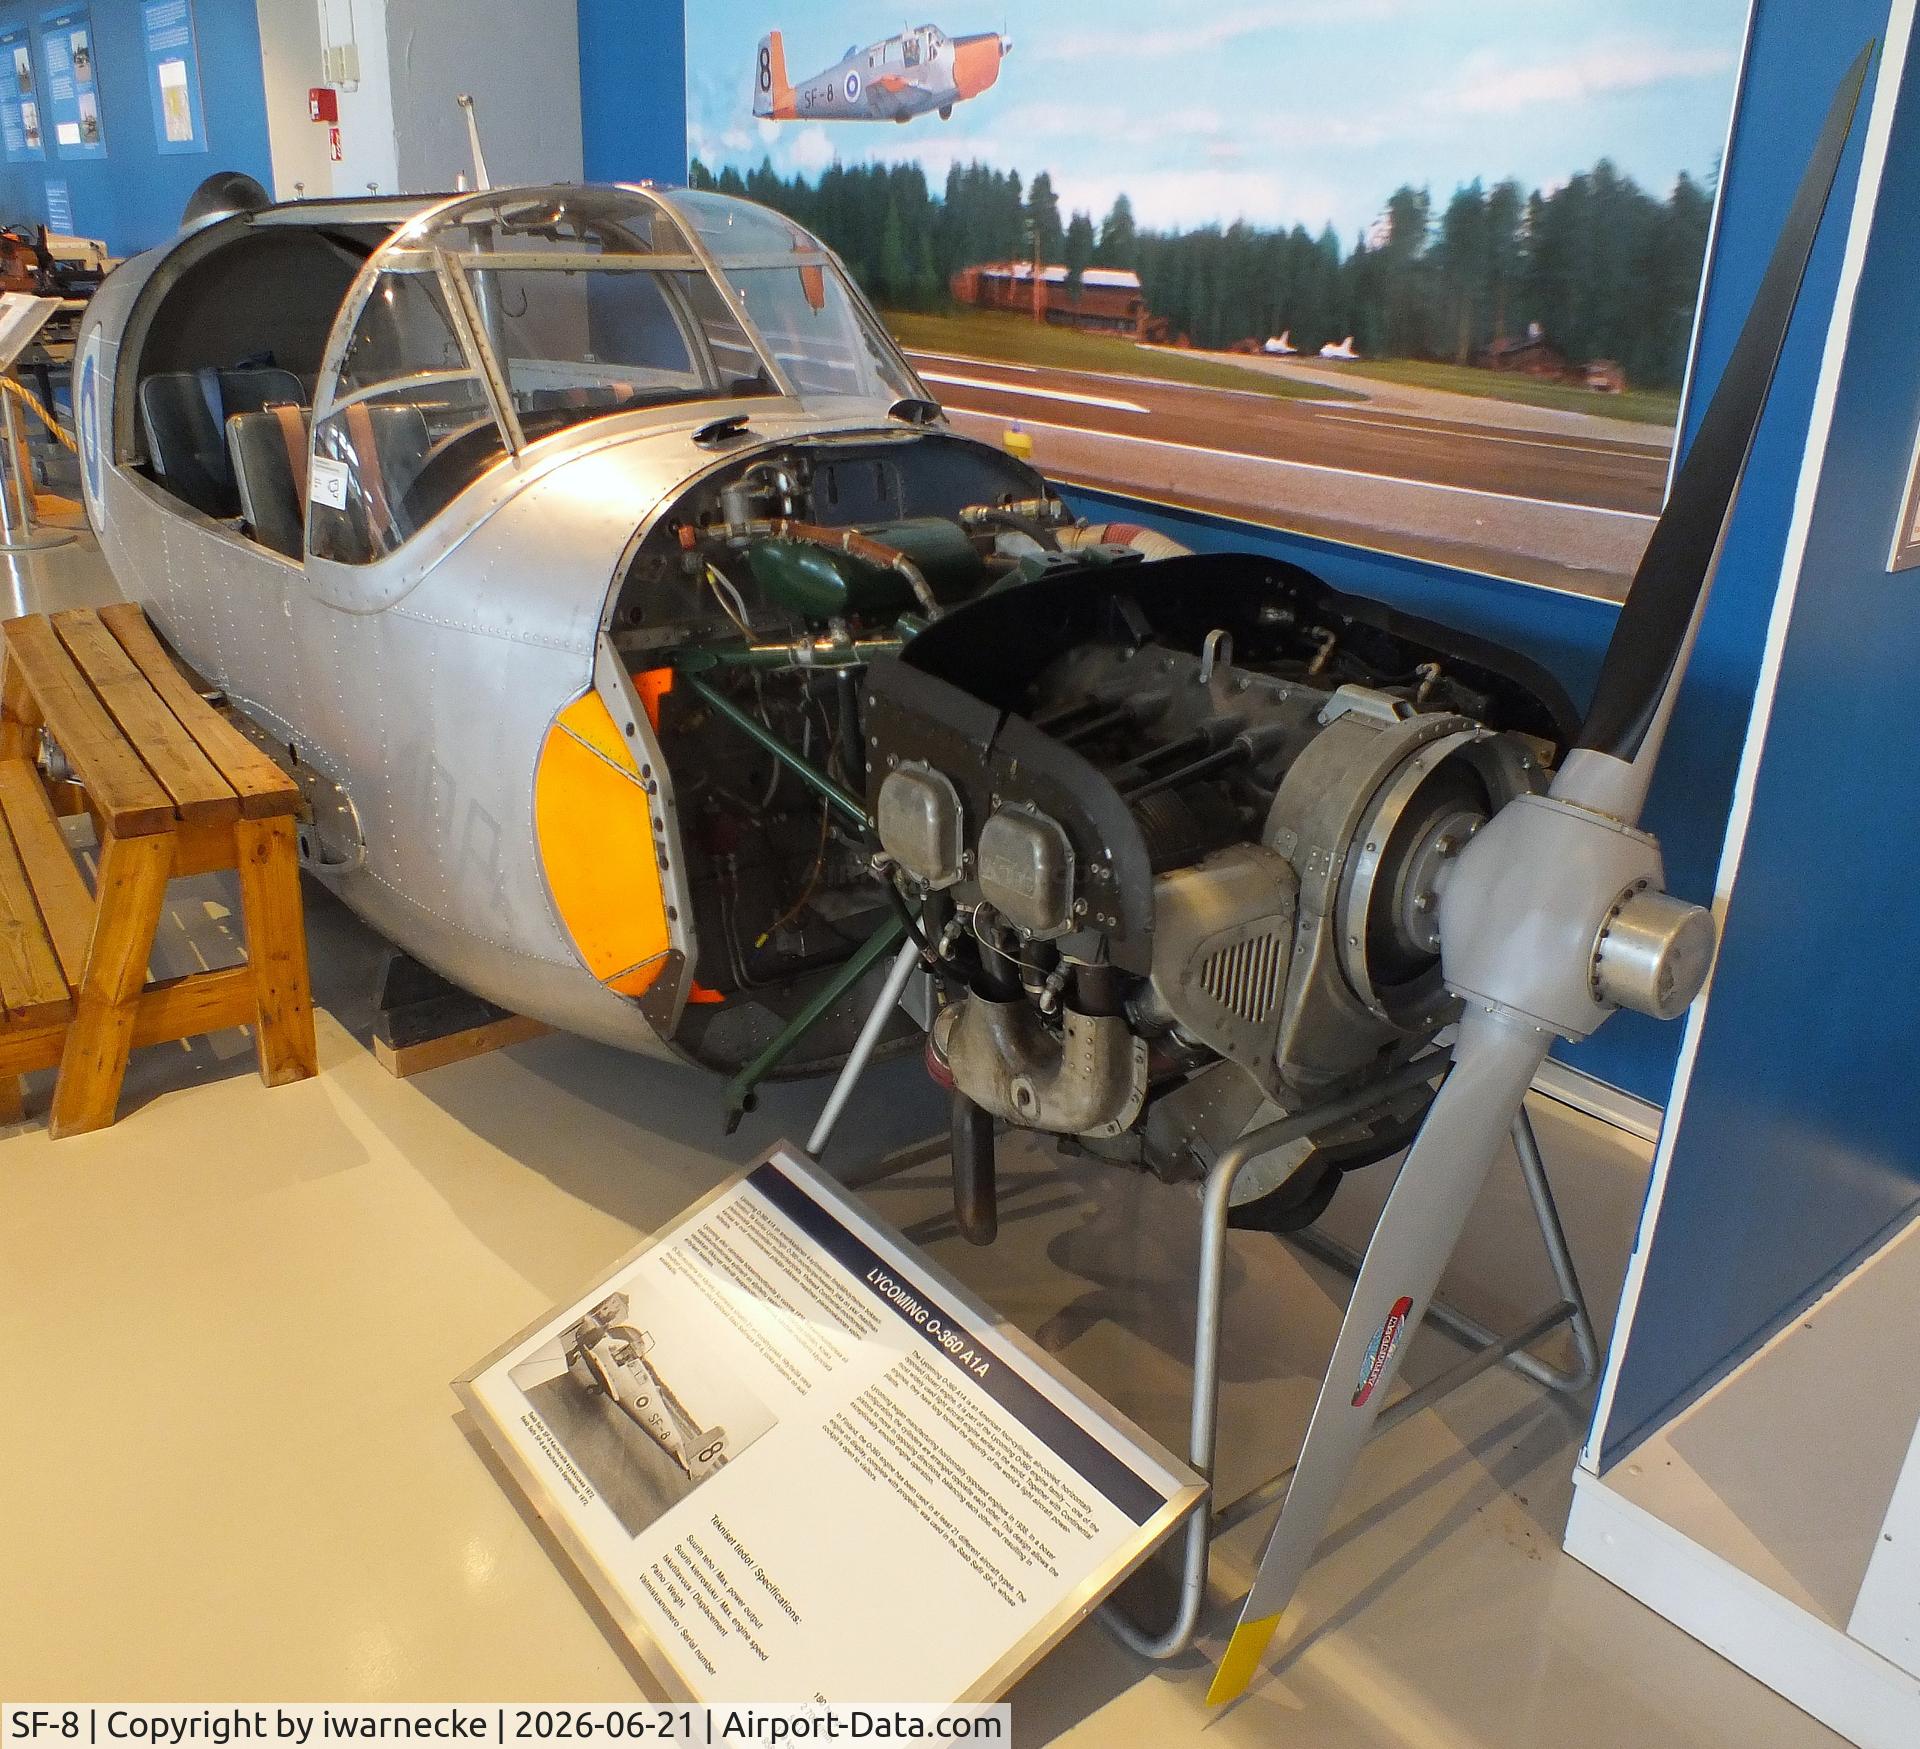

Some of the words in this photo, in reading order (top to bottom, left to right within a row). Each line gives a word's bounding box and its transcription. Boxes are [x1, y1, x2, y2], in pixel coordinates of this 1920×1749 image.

[759, 47, 771, 92] 8
[804, 83, 834, 109] SF-8
[865, 1268, 931, 1324] LYCOMING
[924, 1319, 966, 1354] O-360
[959, 1349, 992, 1377] A1A
[648, 1413, 671, 1441] SF-8
[699, 1441, 724, 1462] 8
[821, 1424, 840, 1442] cockpit
[841, 1444, 855, 1458] open
[869, 1383, 892, 1406] Lycoming
[890, 1403, 907, 1419] began
[904, 1417, 939, 1451] manufacturing
[937, 1447, 967, 1477] horizontally
[986, 1495, 1009, 1516] engines
[1038, 1542, 1056, 1560] boxer
[876, 1428, 897, 1446] smooth
[893, 1444, 912, 1462] engine
[896, 1361, 911, 1374] most
[908, 1372, 925, 1388] widely
[922, 1385, 938, 1398] used
[934, 1395, 948, 1407] light
[944, 1405, 965, 1423] aircraft
[961, 1420, 980, 1438] engine
[978, 1436, 996, 1452] series
[1024, 1476, 1050, 1501] Together
[1048, 1499, 1063, 1512] with
[1059, 1509, 1094, 1540] Continental
[908, 1383, 921, 1396] they
[918, 1392, 932, 1406] have
[929, 1403, 943, 1416] long
[940, 1412, 960, 1431] formed
[966, 1437, 988, 1458] majority
[1019, 1485, 1034, 1499] light
[1031, 1497, 1054, 1516] aircraft
[919, 1357, 942, 1380] Lycoming
[977, 1409, 1002, 1432] American
[1059, 1482, 1093, 1514] horizontally
[921, 1372, 942, 1391] (boxer)
[964, 1411, 979, 1422] part
[989, 1432, 1015, 1458] Lycoming
[1029, 1469, 1049, 1487] engine
[828, 1418, 845, 1435] engine
[866, 1456, 889, 1479] complete
[886, 1477, 900, 1489] with
[929, 1519, 945, 1534] used
[955, 1545, 973, 1562] Saab
[996, 1587, 1015, 1606] whose
[877, 1416, 892, 1430] move
[894, 1433, 918, 1456] opposing
[940, 1476, 966, 1503] balancing
[964, 1500, 980, 1514] each
[977, 1512, 993, 1528] other
[1001, 1536, 1027, 1561] resulting
[878, 1455, 896, 1472] engine
[902, 1478, 917, 1494] been
[914, 1491, 930, 1506] used
[937, 1513, 954, 1529] least
[957, 1533, 982, 1557] different
[978, 1555, 1000, 1575] aircraft
[900, 1425, 923, 1447] cylinders
[929, 1453, 954, 1476] arranged
[950, 1474, 974, 1496] opposite
[971, 1494, 988, 1508] each
[999, 1520, 1014, 1534] This
[1011, 1531, 1032, 1551] design
[1029, 1549, 1050, 1568] allows
[638, 1572, 680, 1627] Valmistusnumero
[679, 1628, 699, 1650] Serial
[694, 1648, 717, 1676] number
[650, 1562, 666, 1583] Paino
[666, 1583, 687, 1608] Weight
[661, 1552, 692, 1591] Iskutilavuus
[692, 1591, 729, 1637] Displacement
[673, 1543, 692, 1566] Suurin
[689, 1563, 719, 1599] kierrosluku
[718, 1599, 733, 1619] Max.
[731, 1617, 752, 1641] engine
[748, 1638, 769, 1661] speed
[685, 1533, 704, 1556] Suurin
[701, 1553, 715, 1570] teho
[715, 1570, 729, 1589] Max.
[725, 1586, 746, 1608] power
[742, 1606, 765, 1629] output
[708, 1514, 738, 1547] Tekniset
[732, 1542, 755, 1567] tiedot
[753, 1567, 802, 1625] Specifications:
